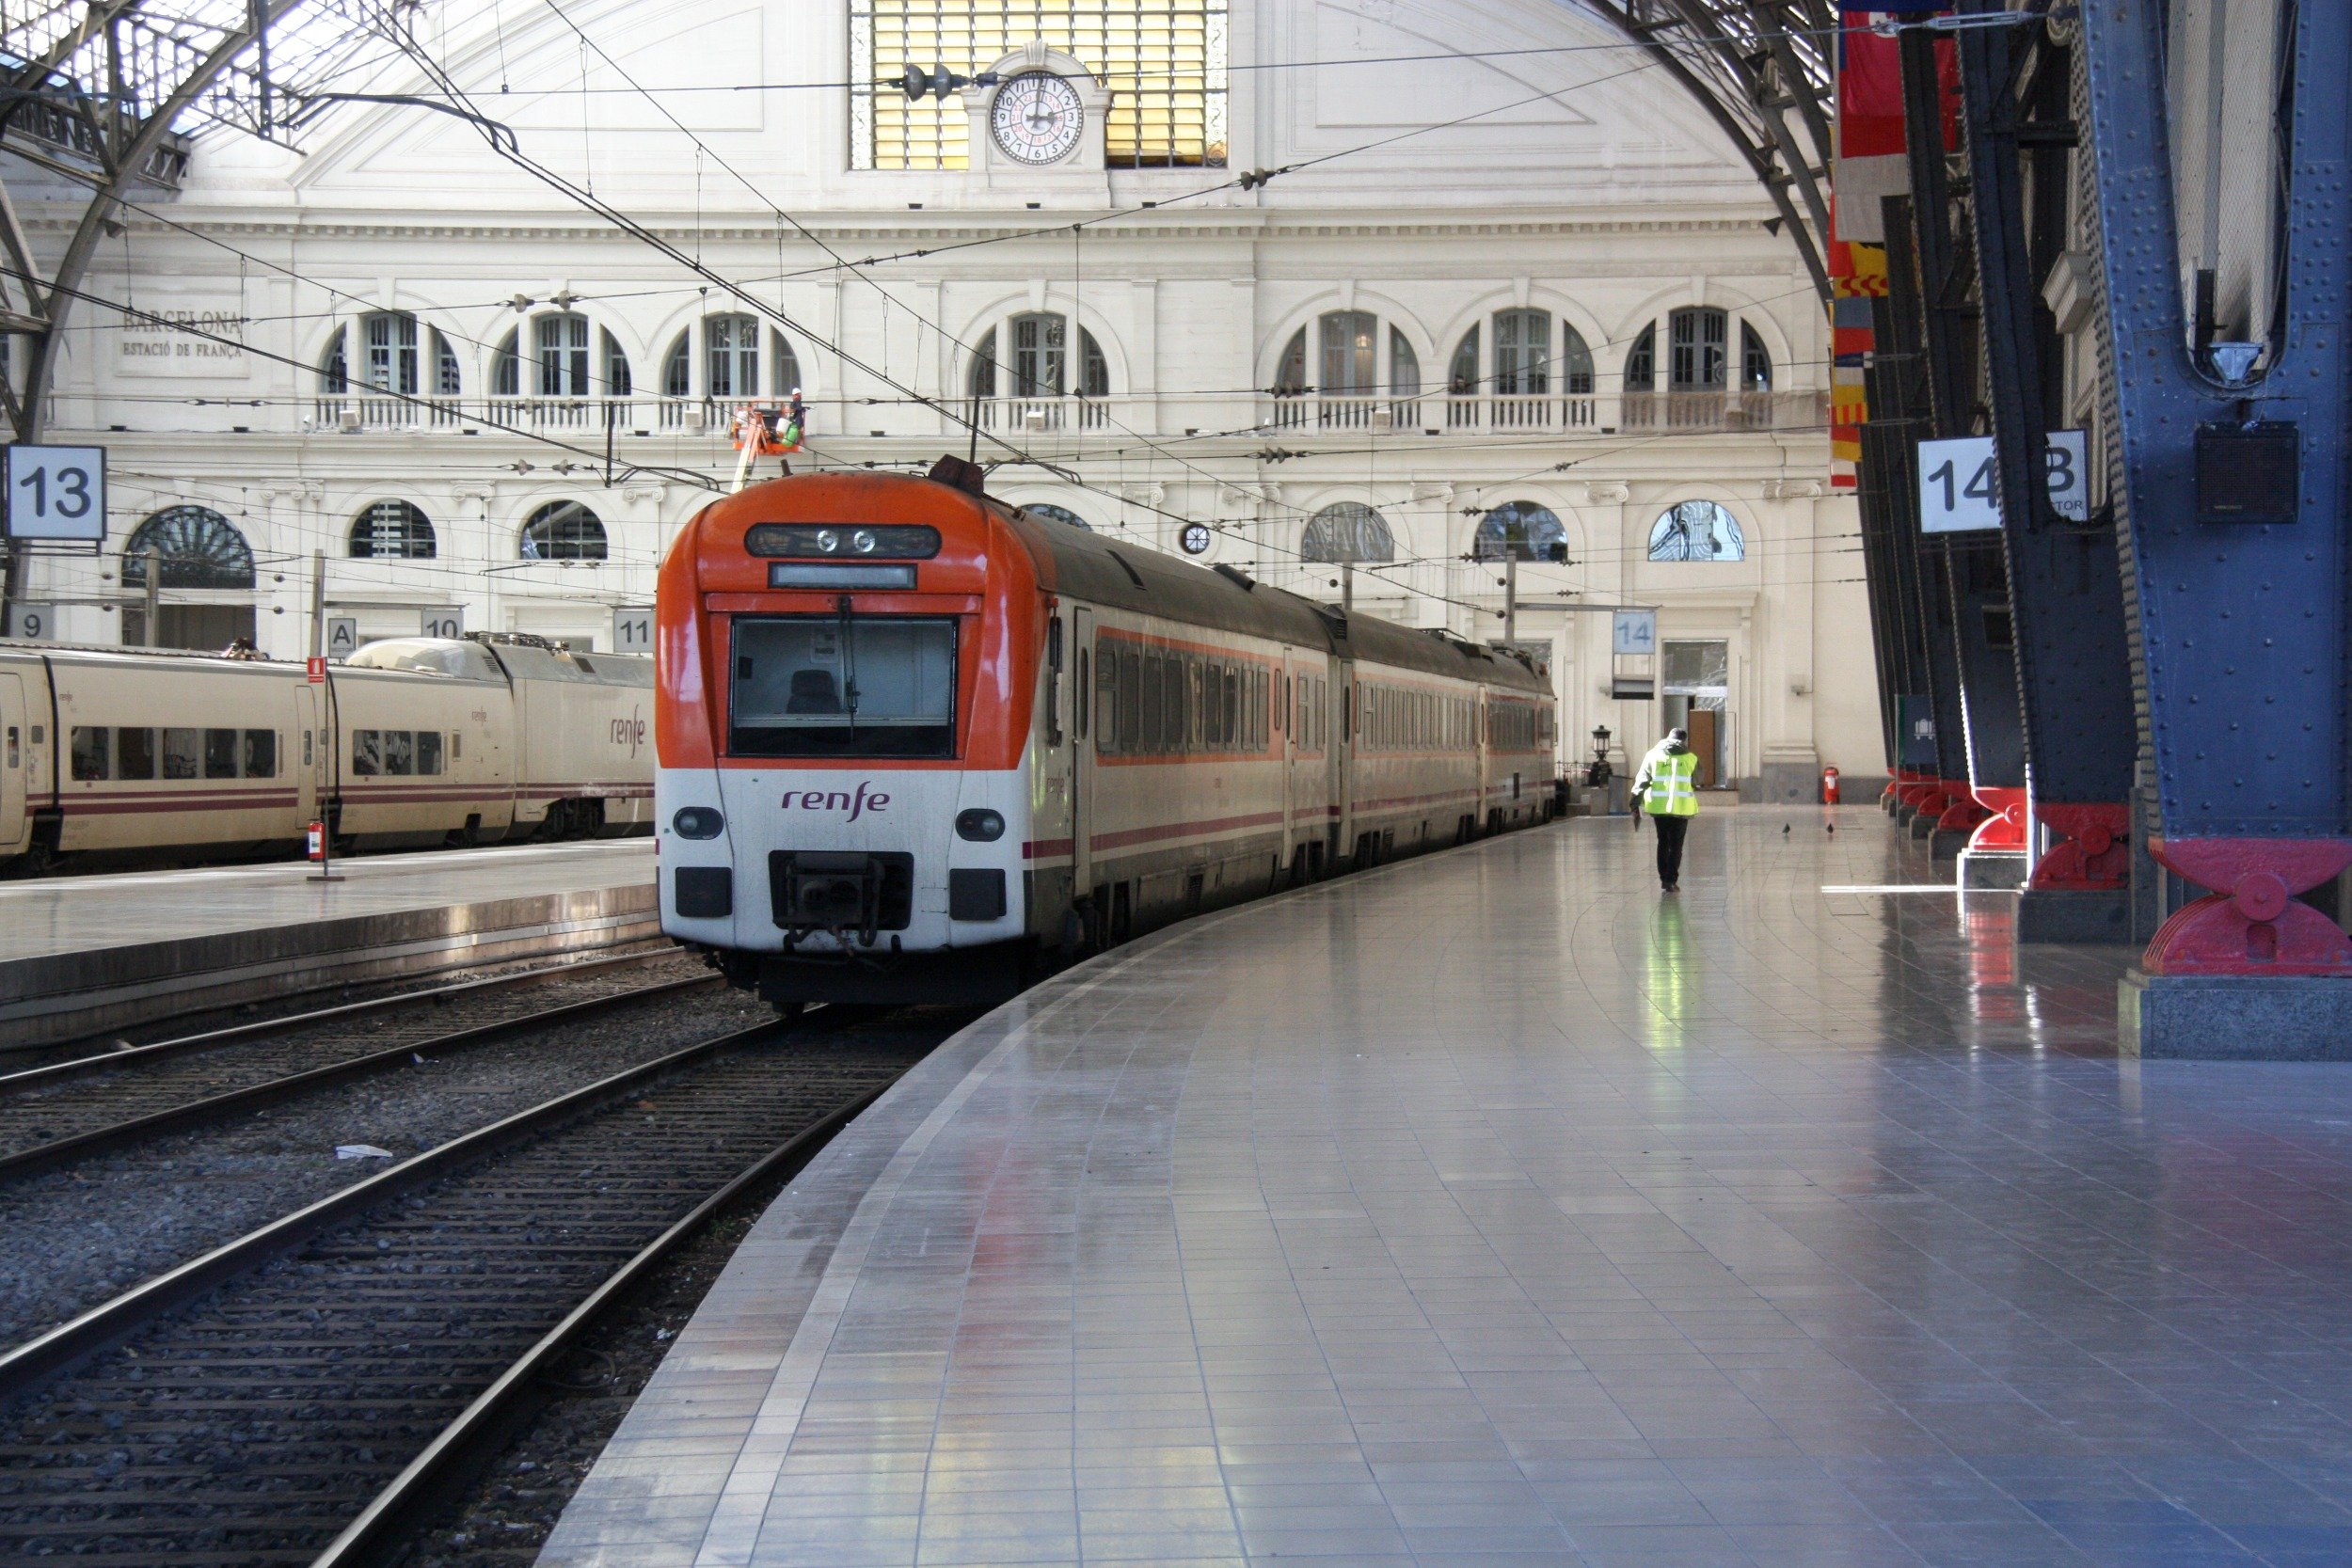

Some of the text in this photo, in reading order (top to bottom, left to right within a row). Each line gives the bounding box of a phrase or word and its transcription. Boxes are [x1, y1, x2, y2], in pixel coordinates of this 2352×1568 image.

[1016, 83, 1025, 92] 11
[1002, 96, 1013, 106] 10
[1065, 96, 1071, 105] 2
[999, 113, 1006, 122] 9
[1068, 112, 1074, 122] 3
[1004, 132, 1009, 141] 8
[1063, 130, 1070, 140] 4
[1016, 143, 1022, 152] 7
[1034, 149, 1041, 158] 6
[1052, 144, 1057, 153] 5
[123, 310, 242, 333] BARCELONA
[123, 341, 243, 359] ESTACIÓ DE FRANÇA
[20, 467, 91, 518] 13
[1928, 456, 1997, 512] 14
[24, 614, 41, 638] 9
[333, 625, 351, 644] A
[426, 619, 458, 638] 10
[620, 620, 647, 643] 11
[676, 621, 709, 645] 14
[611, 704, 645, 759] renfe
[781, 781, 890, 823] renfe
